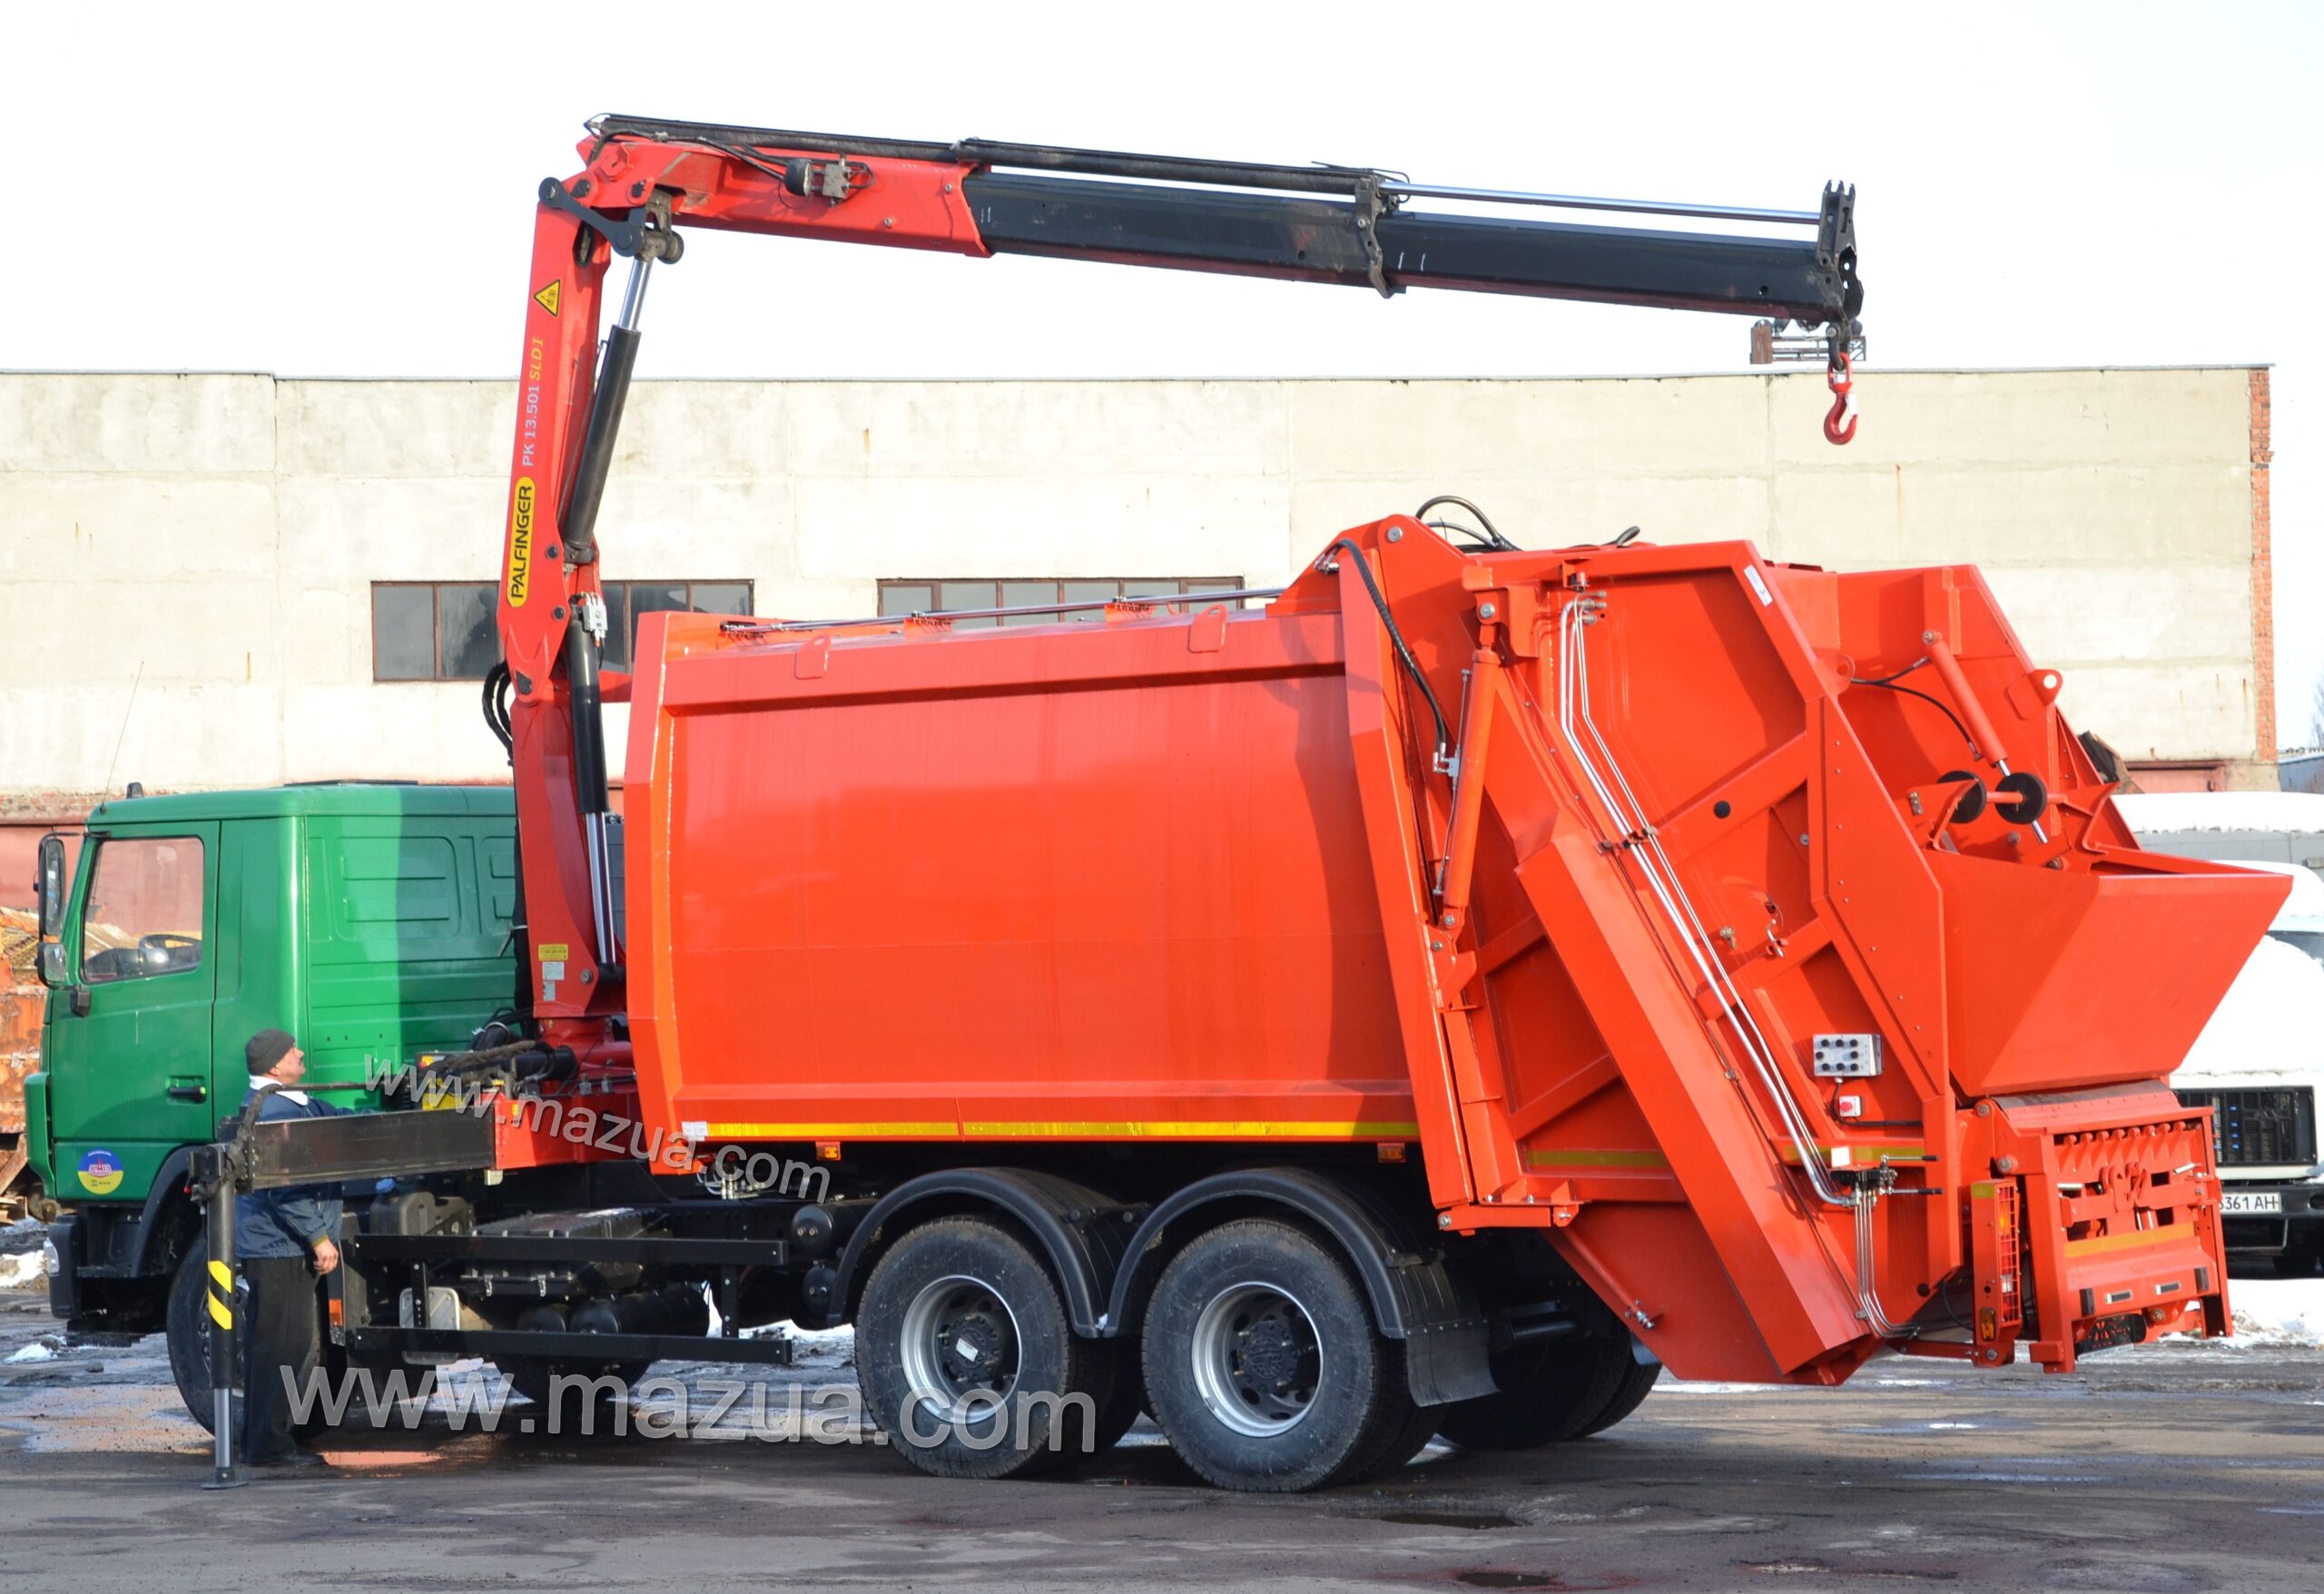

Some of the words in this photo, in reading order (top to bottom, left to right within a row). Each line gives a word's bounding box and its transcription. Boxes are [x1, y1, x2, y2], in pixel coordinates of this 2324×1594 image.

[525, 386, 540, 438] 13.501
[522, 443, 535, 467] PK
[510, 485, 532, 598] PALFINGER
[2254, 1195, 2276, 1210] AH
